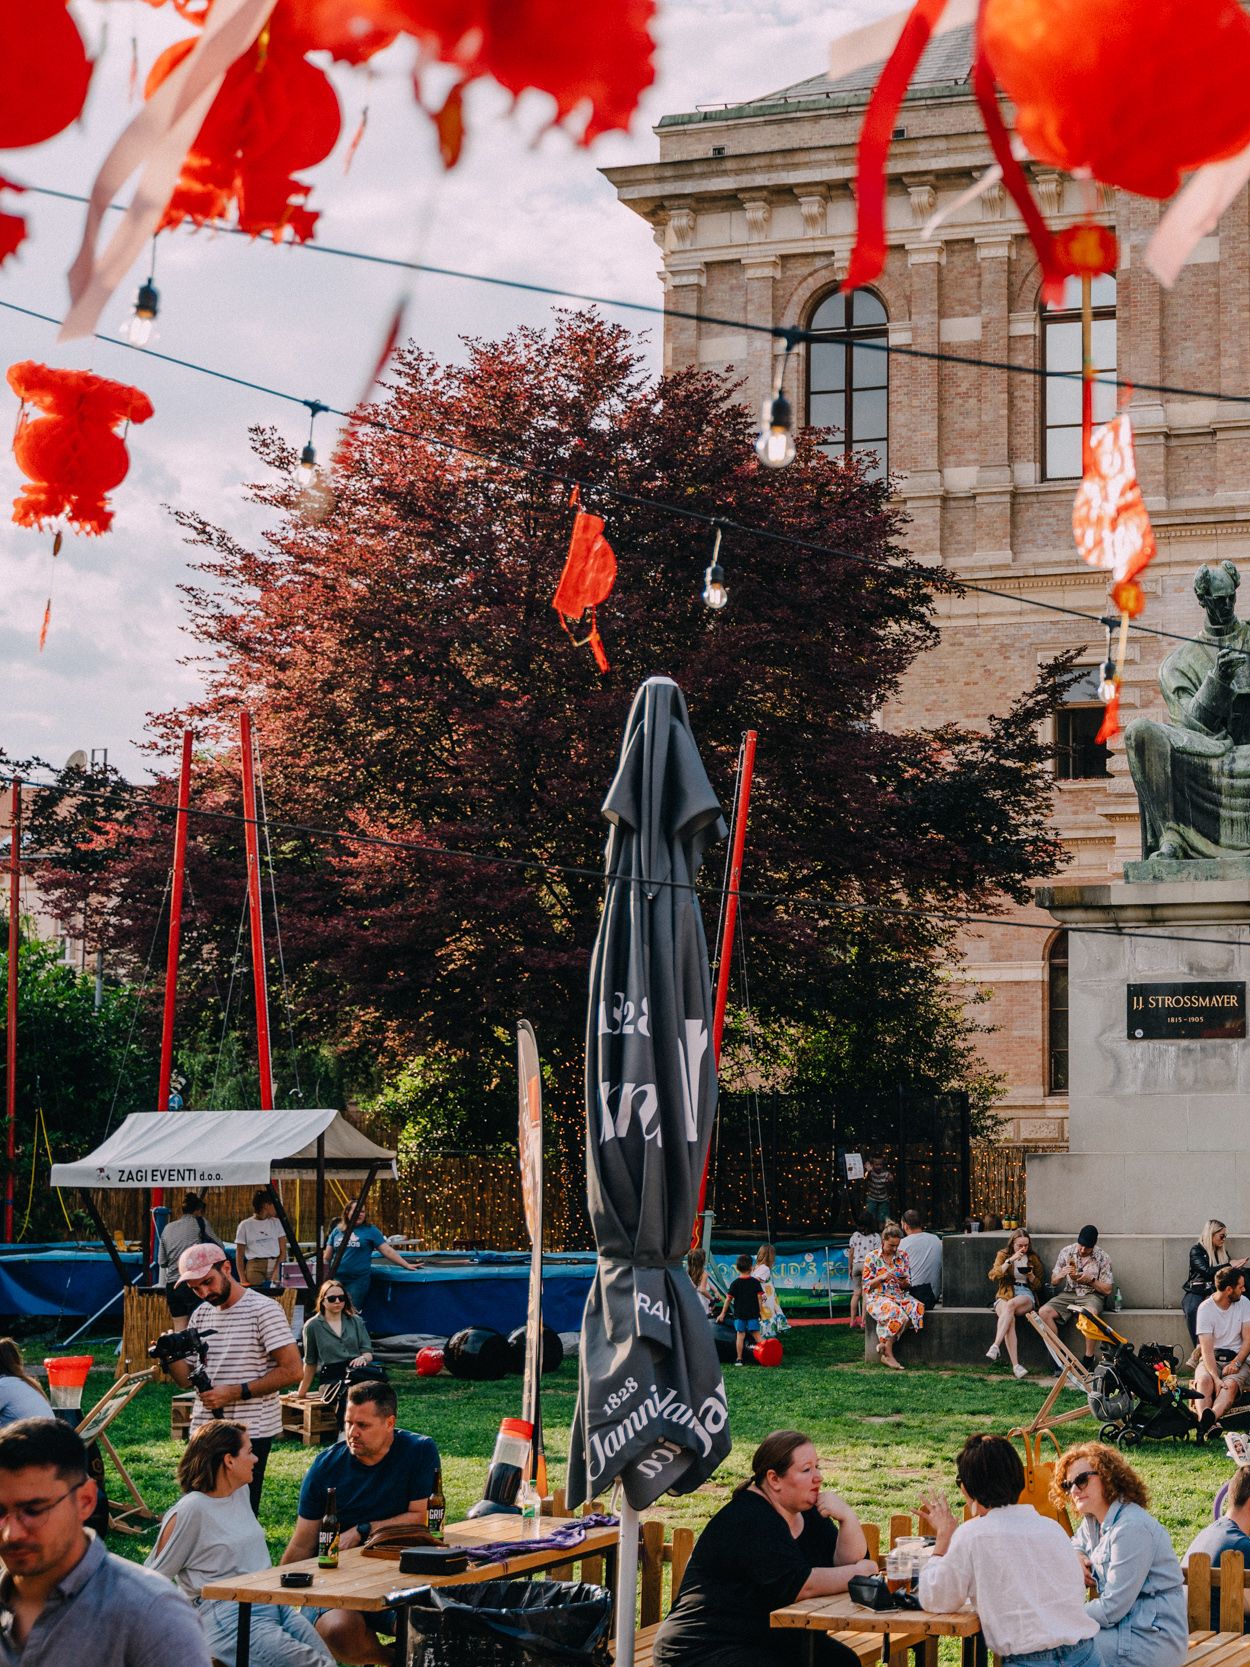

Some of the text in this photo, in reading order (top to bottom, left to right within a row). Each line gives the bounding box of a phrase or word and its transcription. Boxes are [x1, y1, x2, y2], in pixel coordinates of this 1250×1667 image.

[1148, 994, 1239, 1008] STROSSMAYER
[118, 1168, 224, 1182] ZAGI EVENTI d.o.o.
[602, 1376, 639, 1417] 1828
